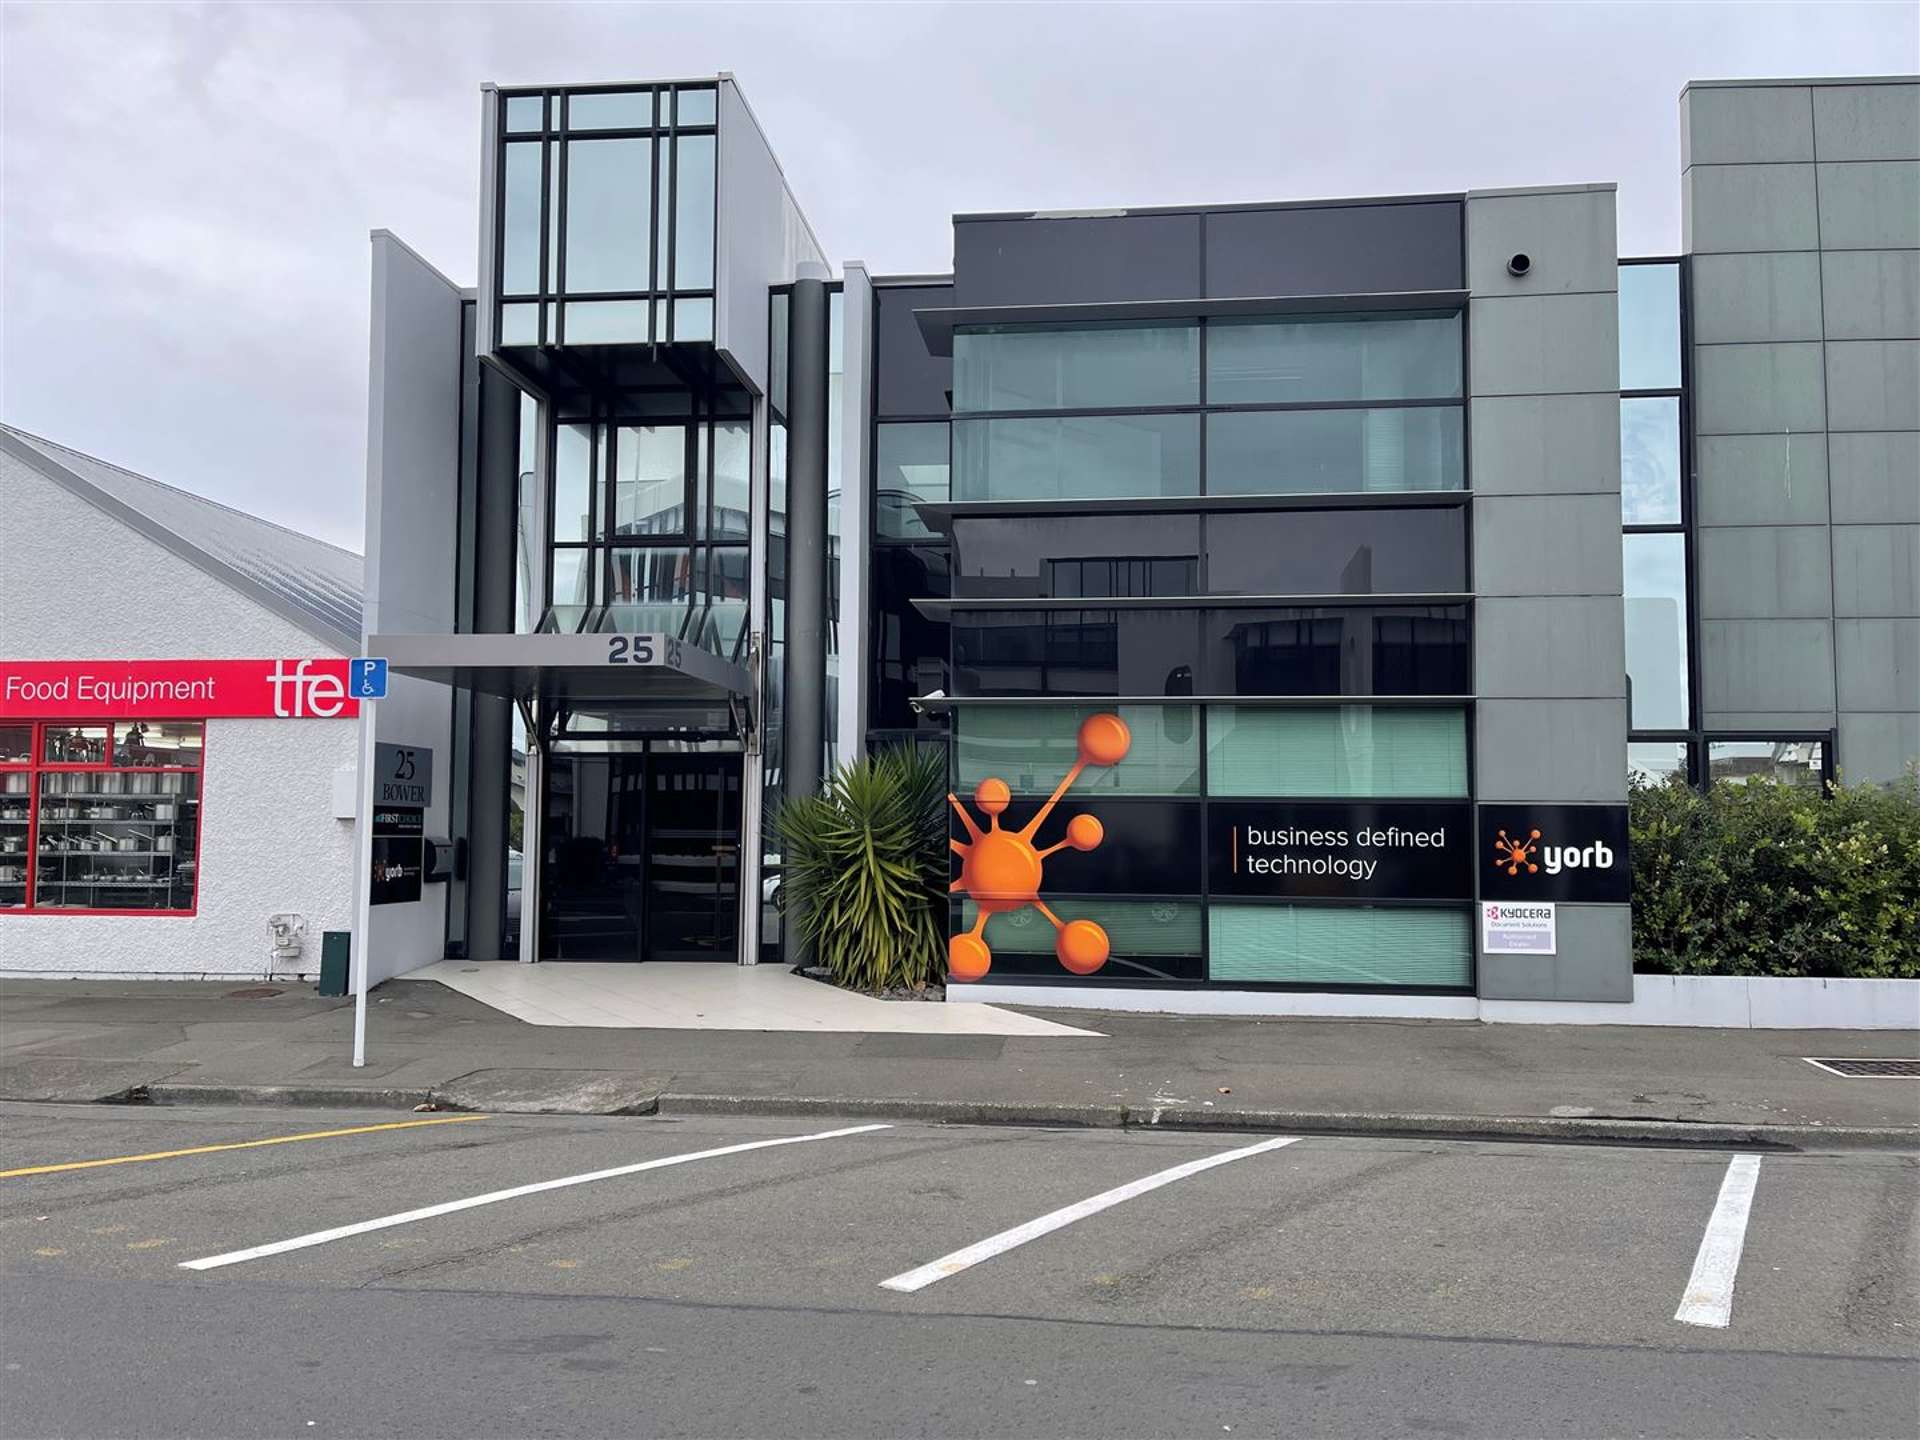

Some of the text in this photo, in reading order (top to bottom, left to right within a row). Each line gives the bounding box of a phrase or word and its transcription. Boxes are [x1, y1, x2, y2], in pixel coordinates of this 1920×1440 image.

[608, 636, 653, 663] 25
[364, 661, 376, 676] P
[6, 676, 216, 705] Food Equipment
[266, 659, 345, 717] tfe
[394, 750, 415, 780] 25
[383, 783, 425, 802] BOWER
[1247, 825, 1445, 847] business defined
[1247, 854, 1377, 880] technology
[1543, 840, 1614, 875] yorb
[1500, 908, 1552, 919] KYOCERA
